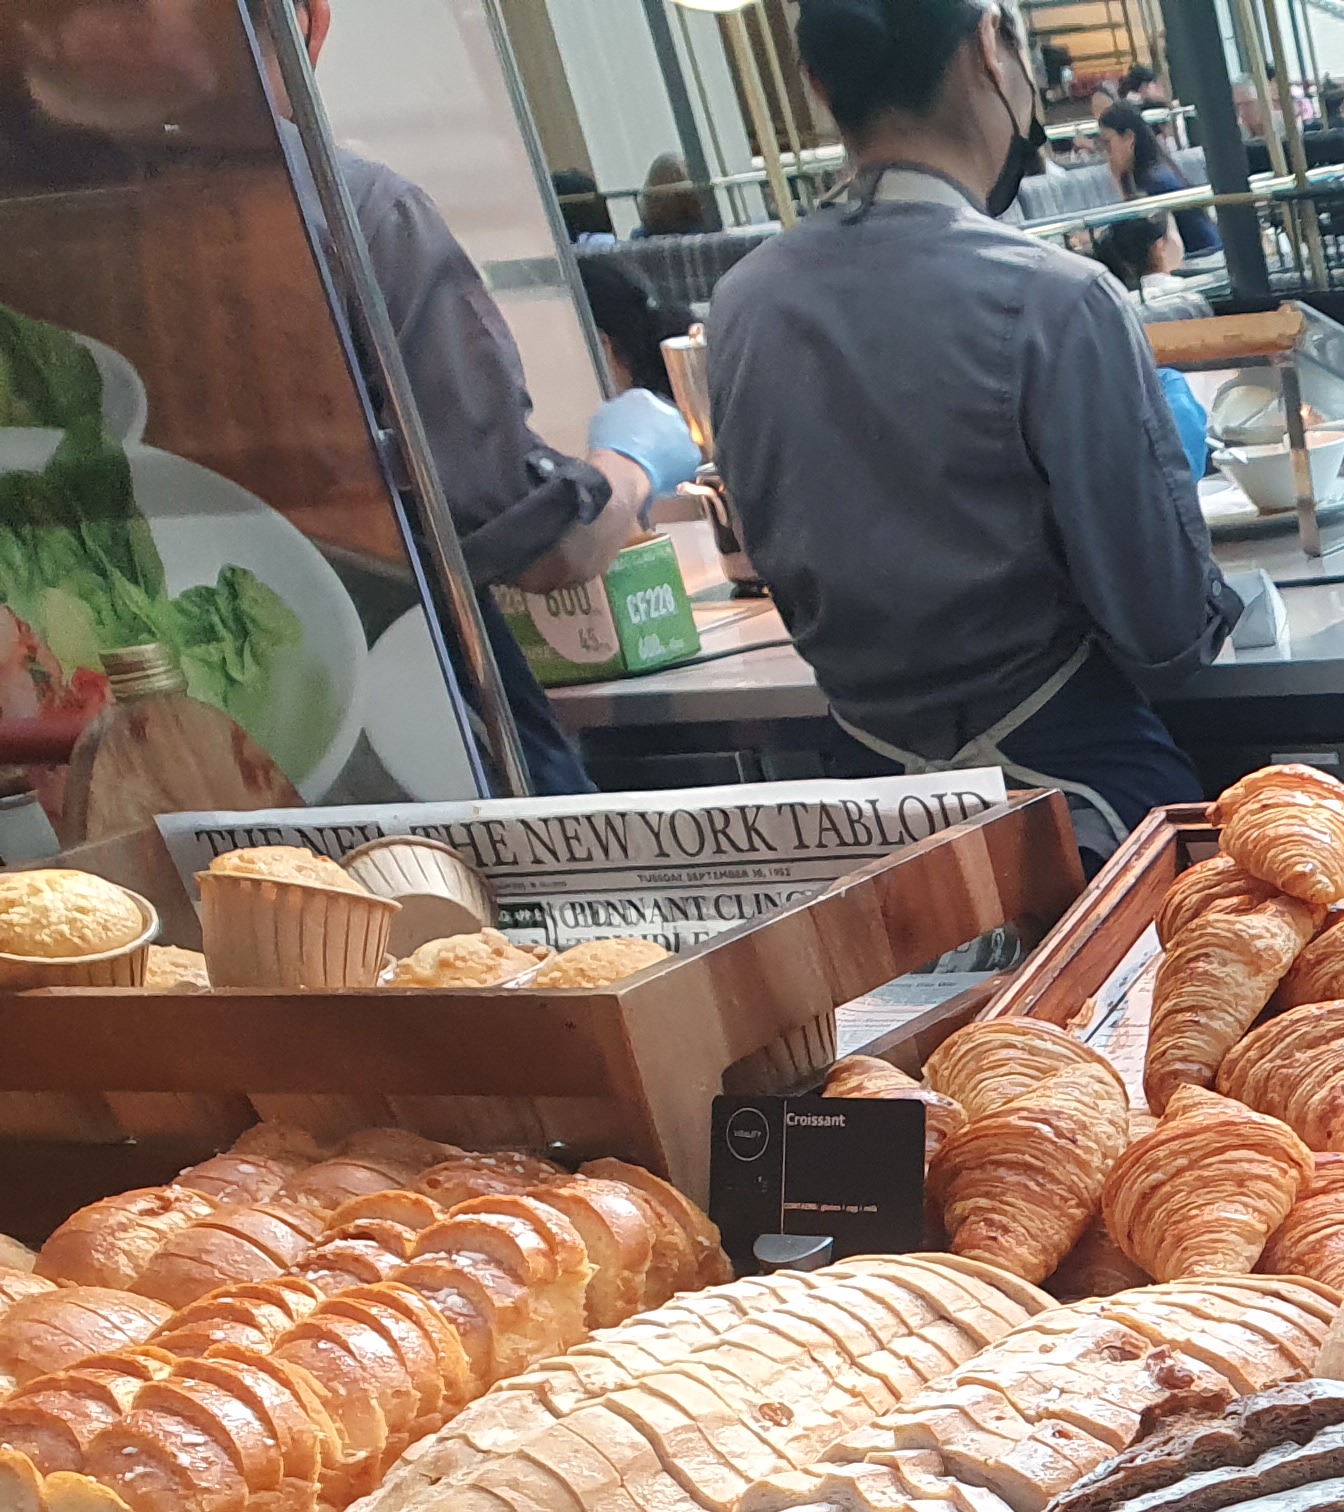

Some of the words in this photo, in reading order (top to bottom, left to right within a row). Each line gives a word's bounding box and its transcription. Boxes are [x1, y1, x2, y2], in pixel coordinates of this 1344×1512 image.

[517, 811, 631, 865] NEW
[634, 803, 778, 859] YORK
[713, 890, 812, 921] CLIN
[785, 1112, 846, 1128] Croissant
